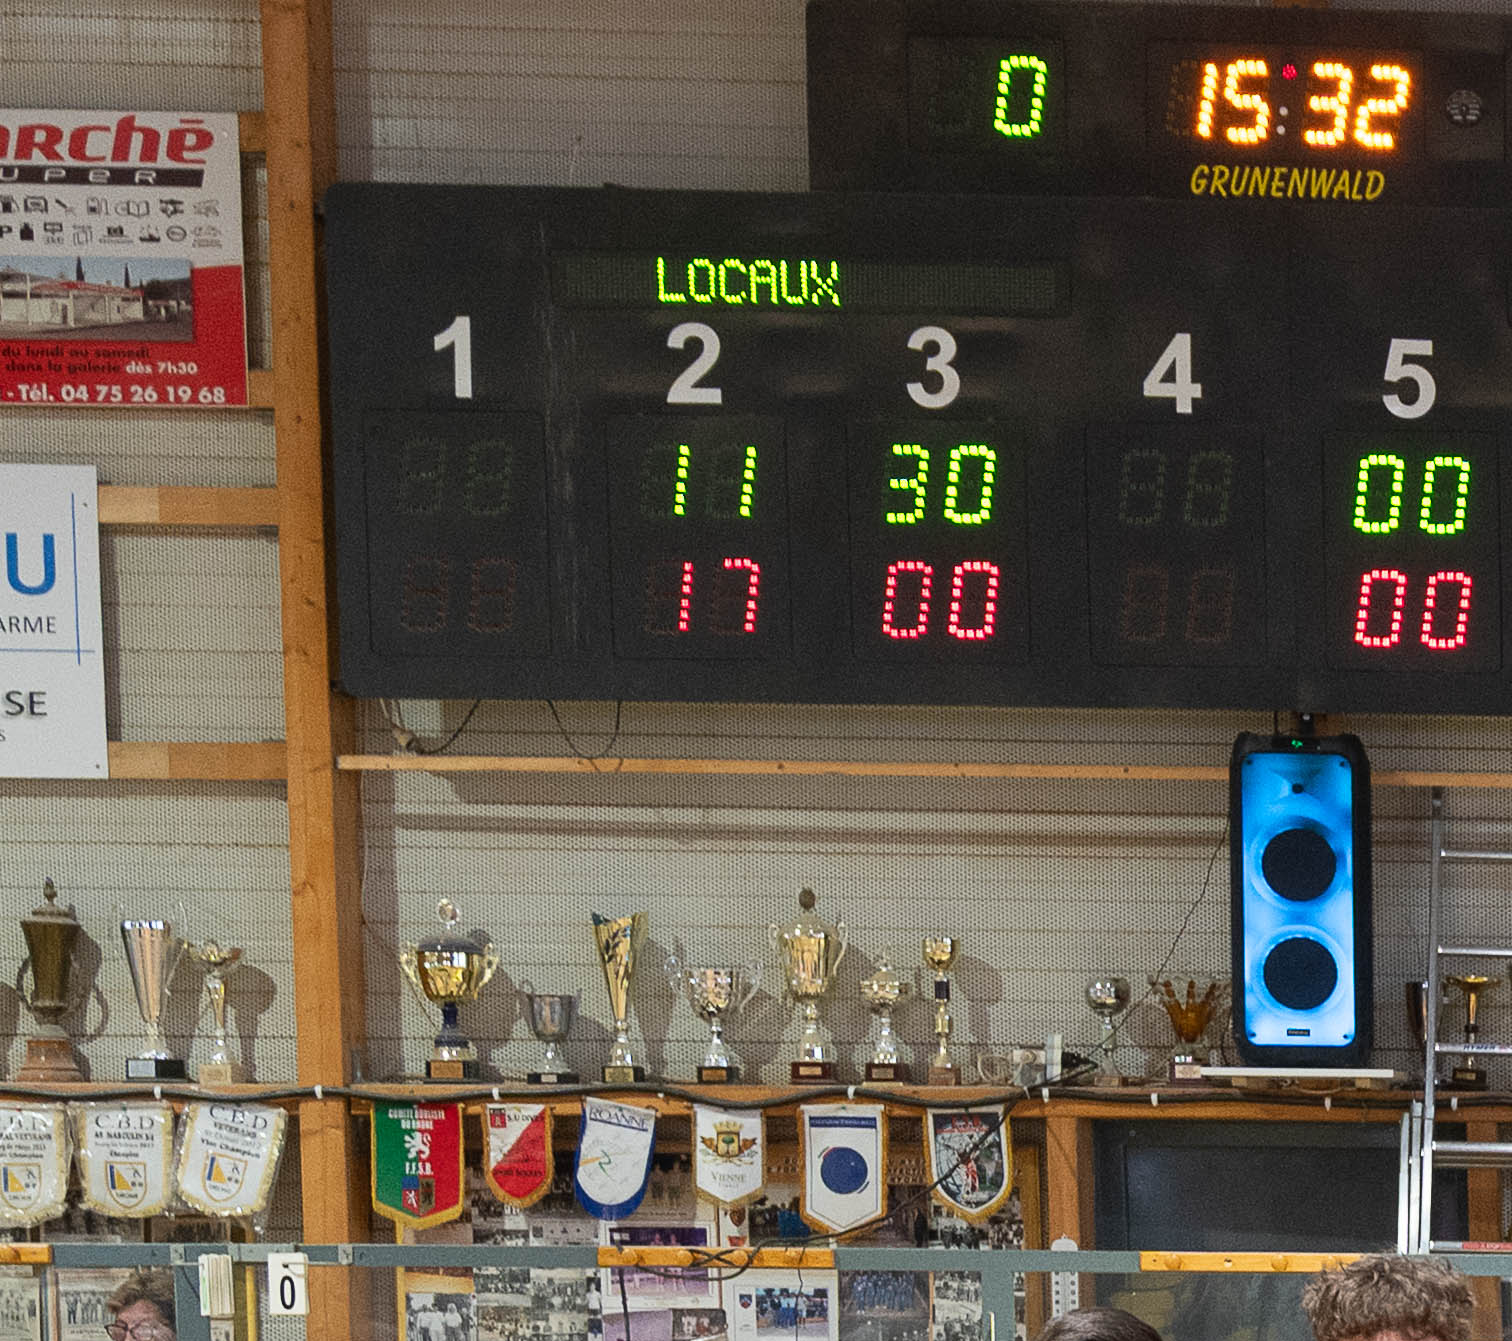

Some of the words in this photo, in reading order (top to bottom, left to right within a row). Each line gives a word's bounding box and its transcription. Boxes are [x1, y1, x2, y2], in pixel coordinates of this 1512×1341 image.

[994, 55, 1048, 138] 0
[1190, 164, 1385, 201] GRUNENWALD
[656, 256, 841, 306] LOCAUX
[18, 384, 53, 401] Tél.
[61, 385, 88, 401] 04
[96, 385, 121, 401] 75
[129, 386, 157, 401] 26
[166, 387, 191, 402] 19
[199, 387, 225, 403] 68
[433, 316, 473, 399] 1
[666, 323, 723, 405] 2
[906, 327, 961, 409] 3
[1142, 332, 1202, 414] 4
[1381, 337, 1437, 418] 5
[673, 444, 757, 518] 11
[886, 444, 996, 524] 30
[1354, 454, 1471, 535] 00
[679, 558, 761, 633] 17
[883, 560, 998, 641] 00
[1355, 568, 1472, 648] 00
[280, 1276, 295, 1310] 0
